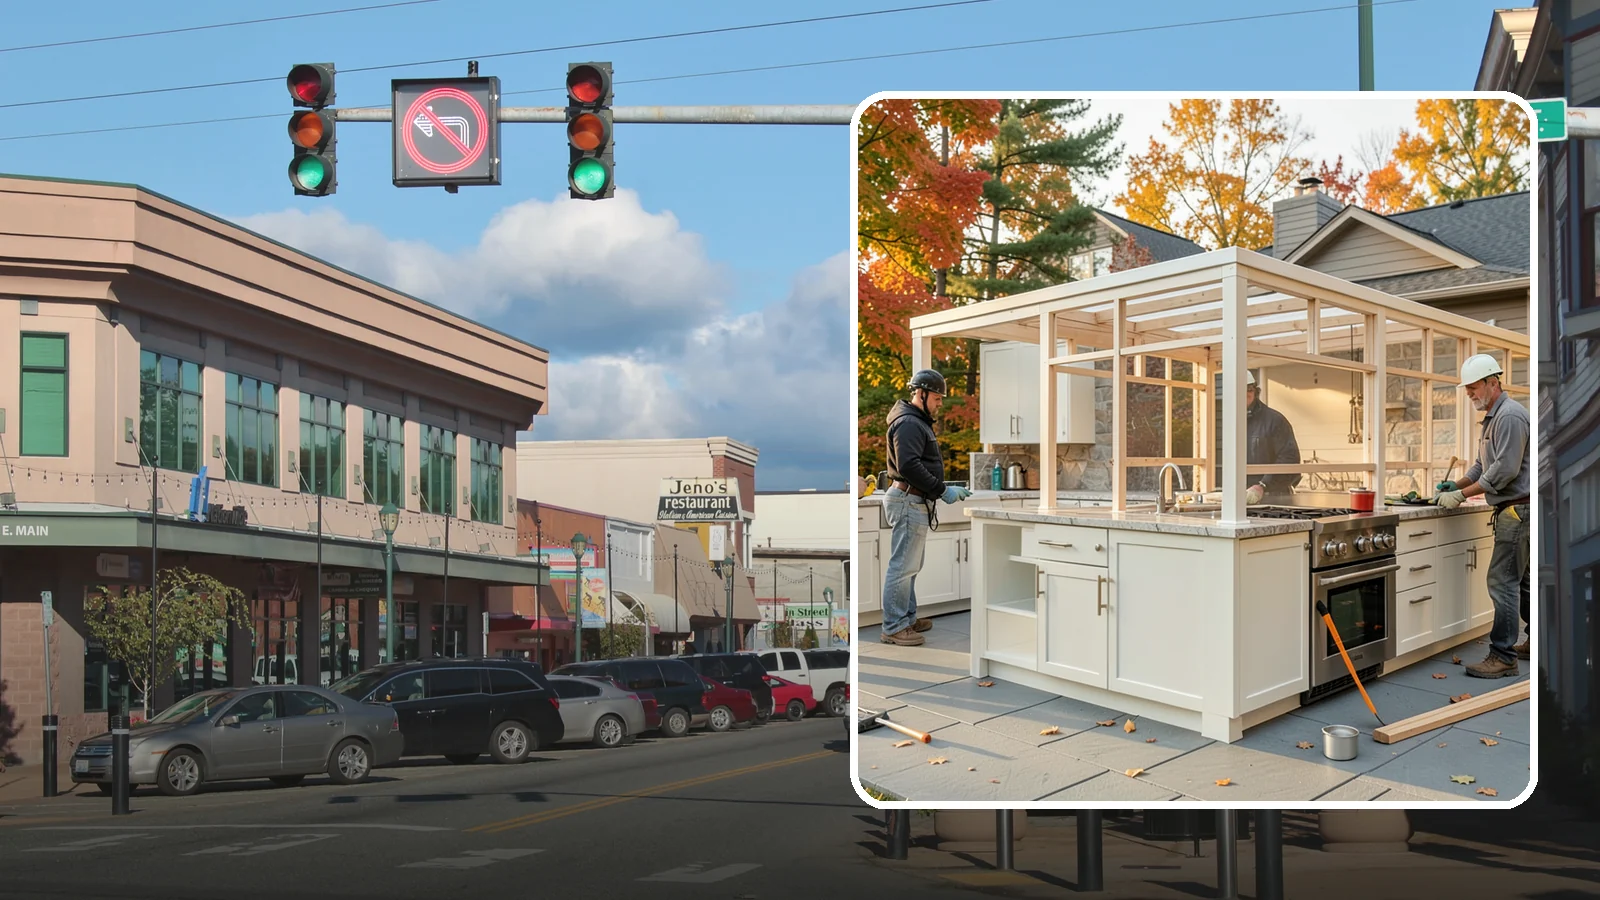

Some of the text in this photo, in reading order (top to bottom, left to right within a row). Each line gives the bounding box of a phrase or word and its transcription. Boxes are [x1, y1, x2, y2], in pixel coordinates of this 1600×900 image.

[669, 480, 727, 494] Jeno's
[664, 496, 731, 509] restaurant
[686, 509, 714, 519] American
[715, 509, 737, 520] Cuisine
[2, 525, 49, 536] E. MAIN
[797, 607, 828, 617] Street
